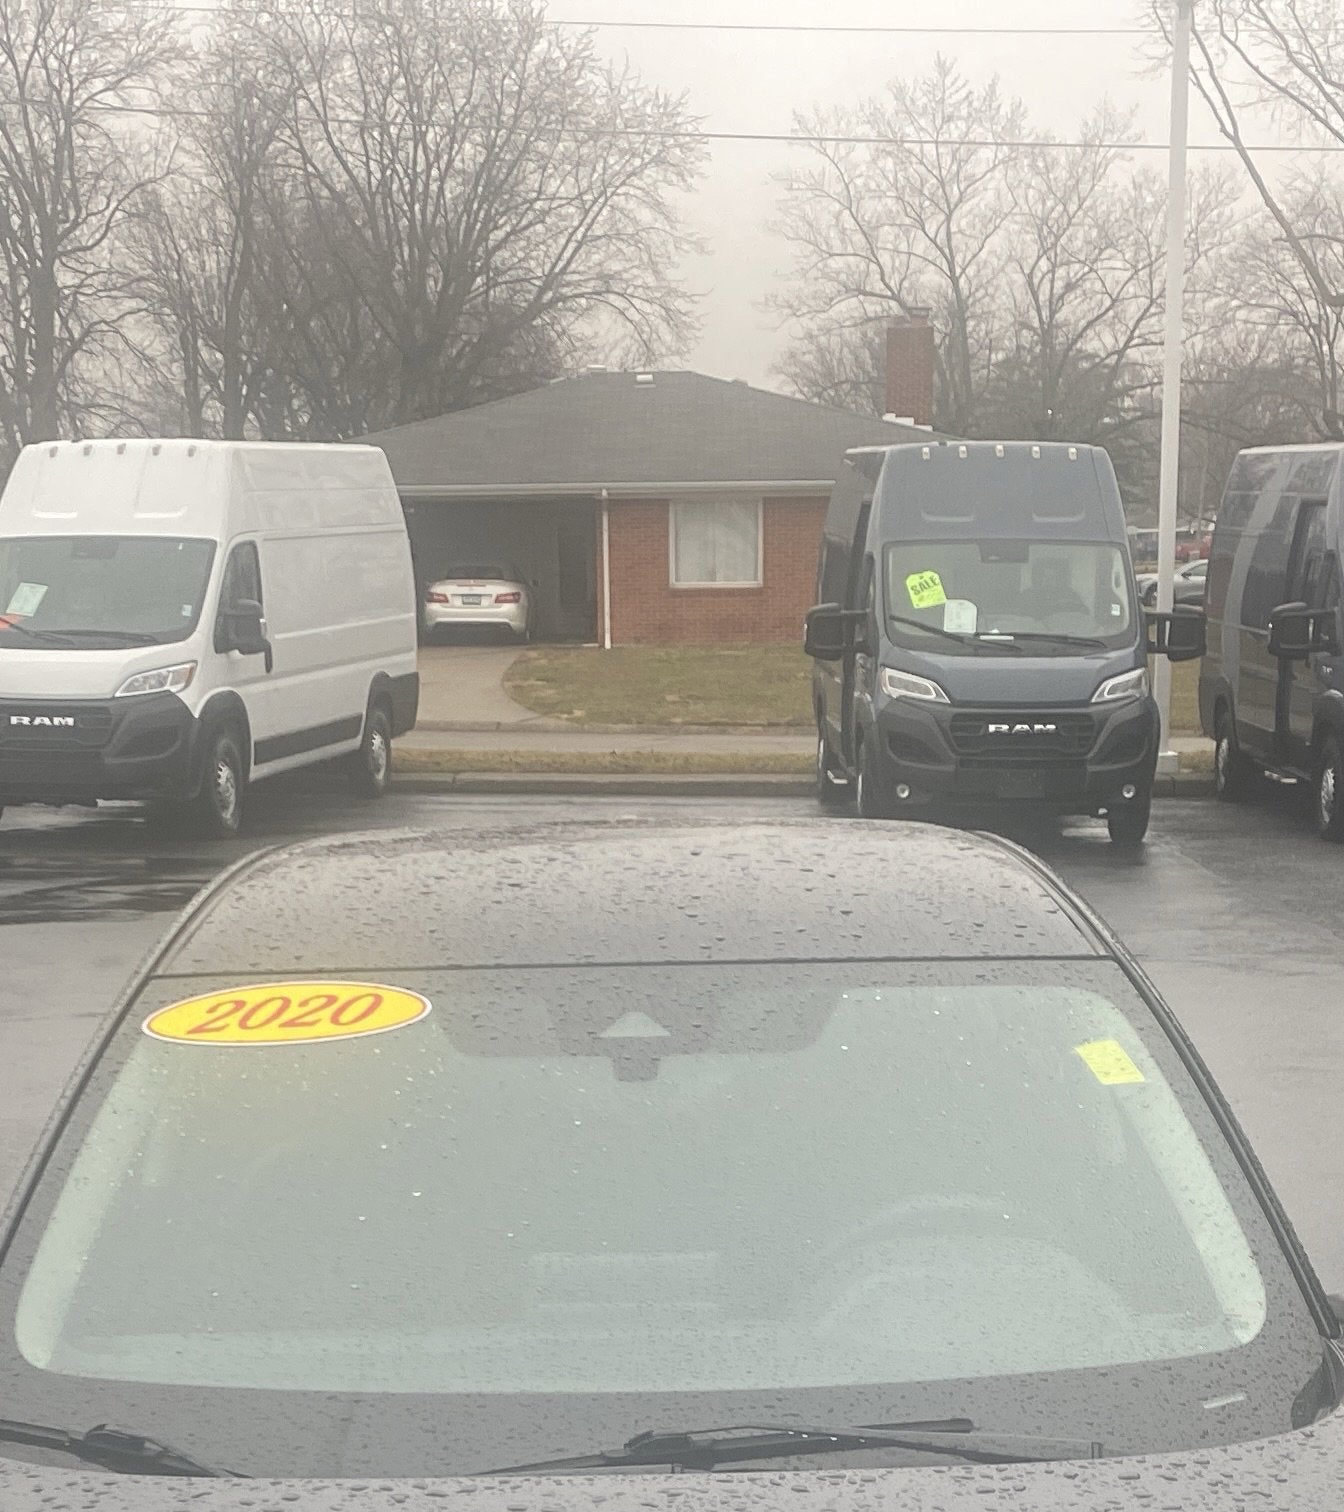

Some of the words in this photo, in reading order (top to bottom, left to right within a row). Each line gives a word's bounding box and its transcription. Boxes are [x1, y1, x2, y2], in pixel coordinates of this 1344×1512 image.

[911, 575, 939, 596] SALE
[10, 716, 75, 726] RAM
[988, 724, 1056, 734] RAM
[186, 993, 384, 1035] 2020
